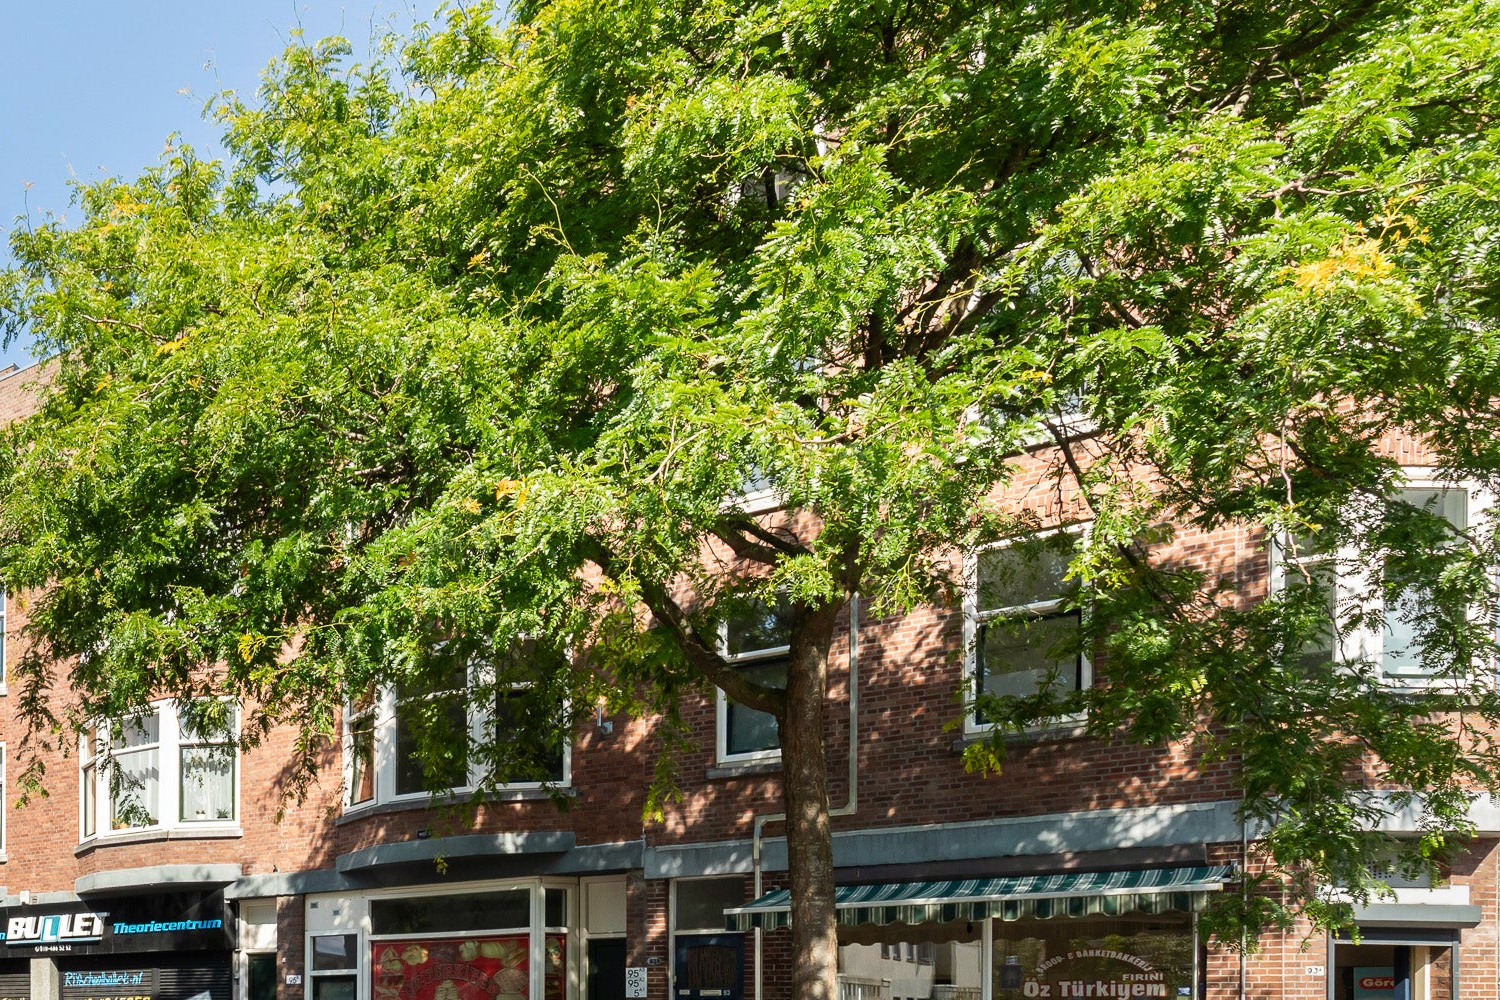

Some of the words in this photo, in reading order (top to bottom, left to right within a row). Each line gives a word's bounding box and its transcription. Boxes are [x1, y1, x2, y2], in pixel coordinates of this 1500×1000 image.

[6, 912, 109, 942] BULLET
[113, 919, 222, 934] Theoriecentrum
[1076, 949, 1154, 971] BANKETBAKKERIJ
[1122, 973, 1164, 981] FIRINI
[1023, 978, 1051, 997] Öz
[1059, 980, 1168, 1000] Türkiyem
